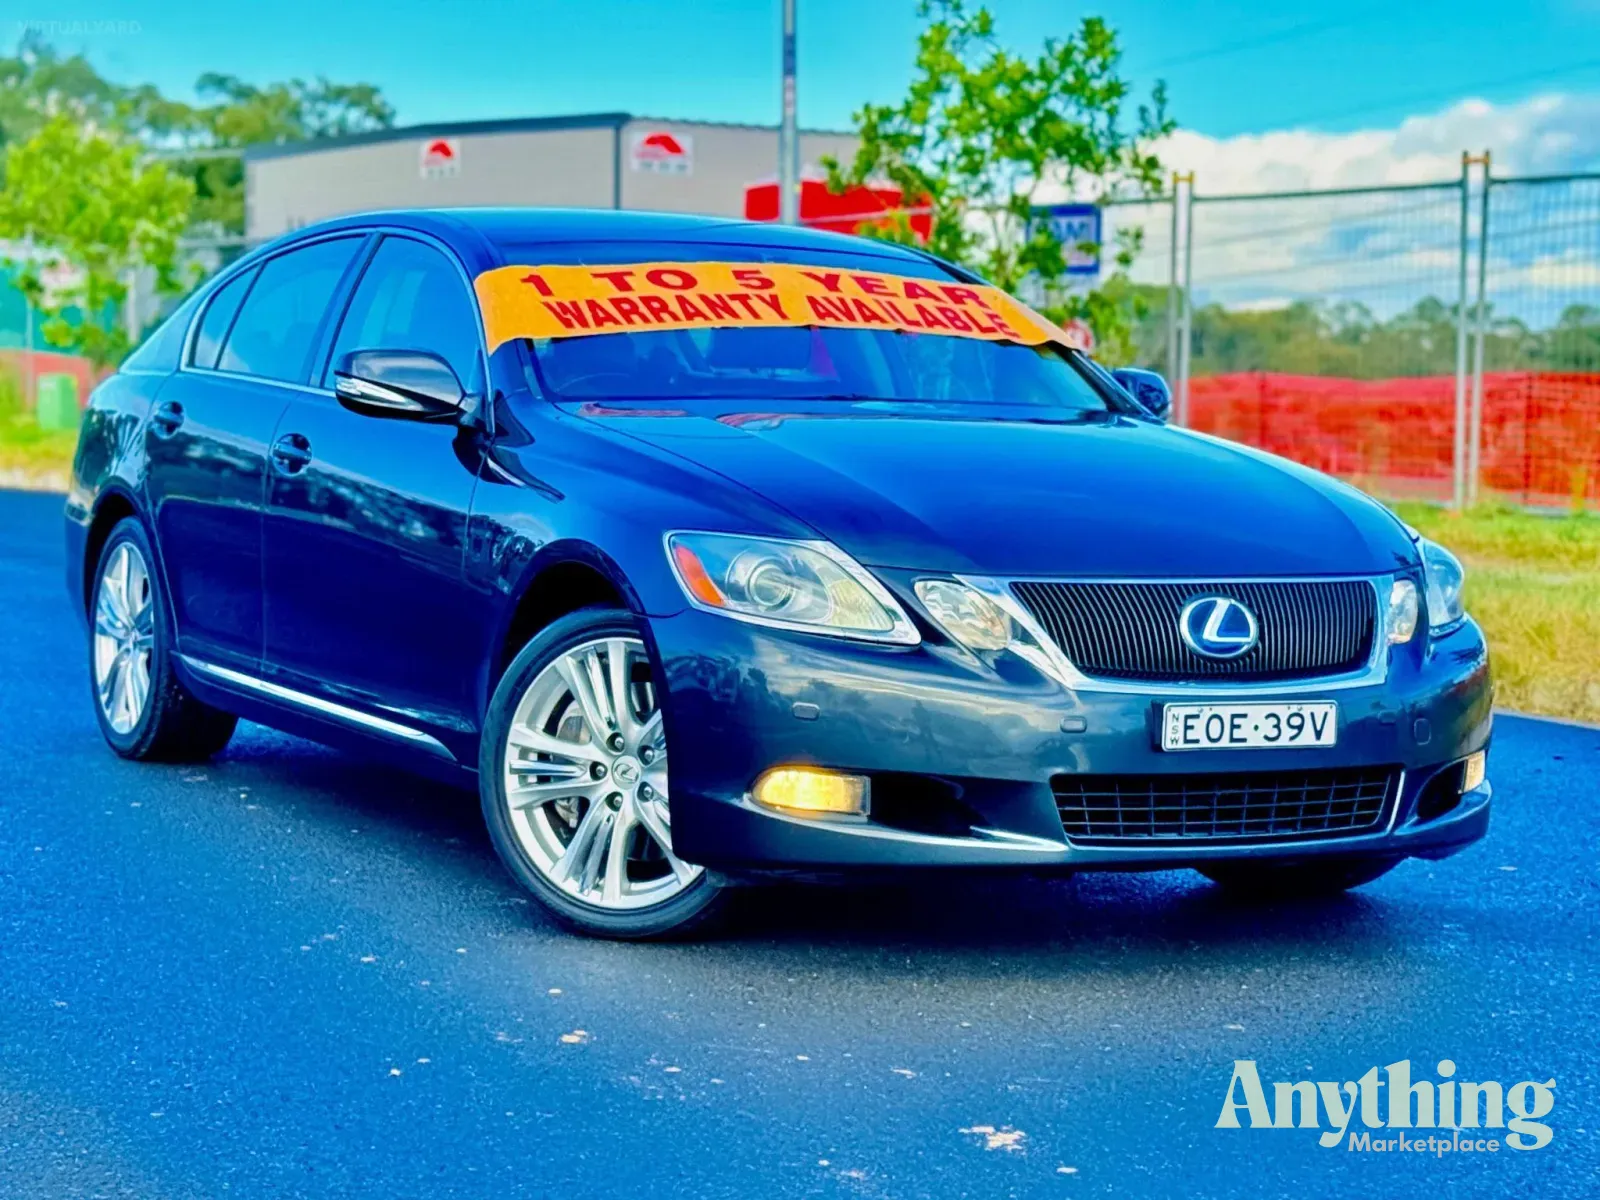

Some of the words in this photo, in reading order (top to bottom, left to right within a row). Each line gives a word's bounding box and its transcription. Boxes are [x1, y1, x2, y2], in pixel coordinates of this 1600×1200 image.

[520, 274, 555, 297] 1
[590, 269, 698, 292] TO
[731, 270, 776, 290] 5
[799, 271, 991, 309] YEAR
[540, 294, 790, 329] WARRANTY
[806, 295, 1020, 340] AVAILABLE
